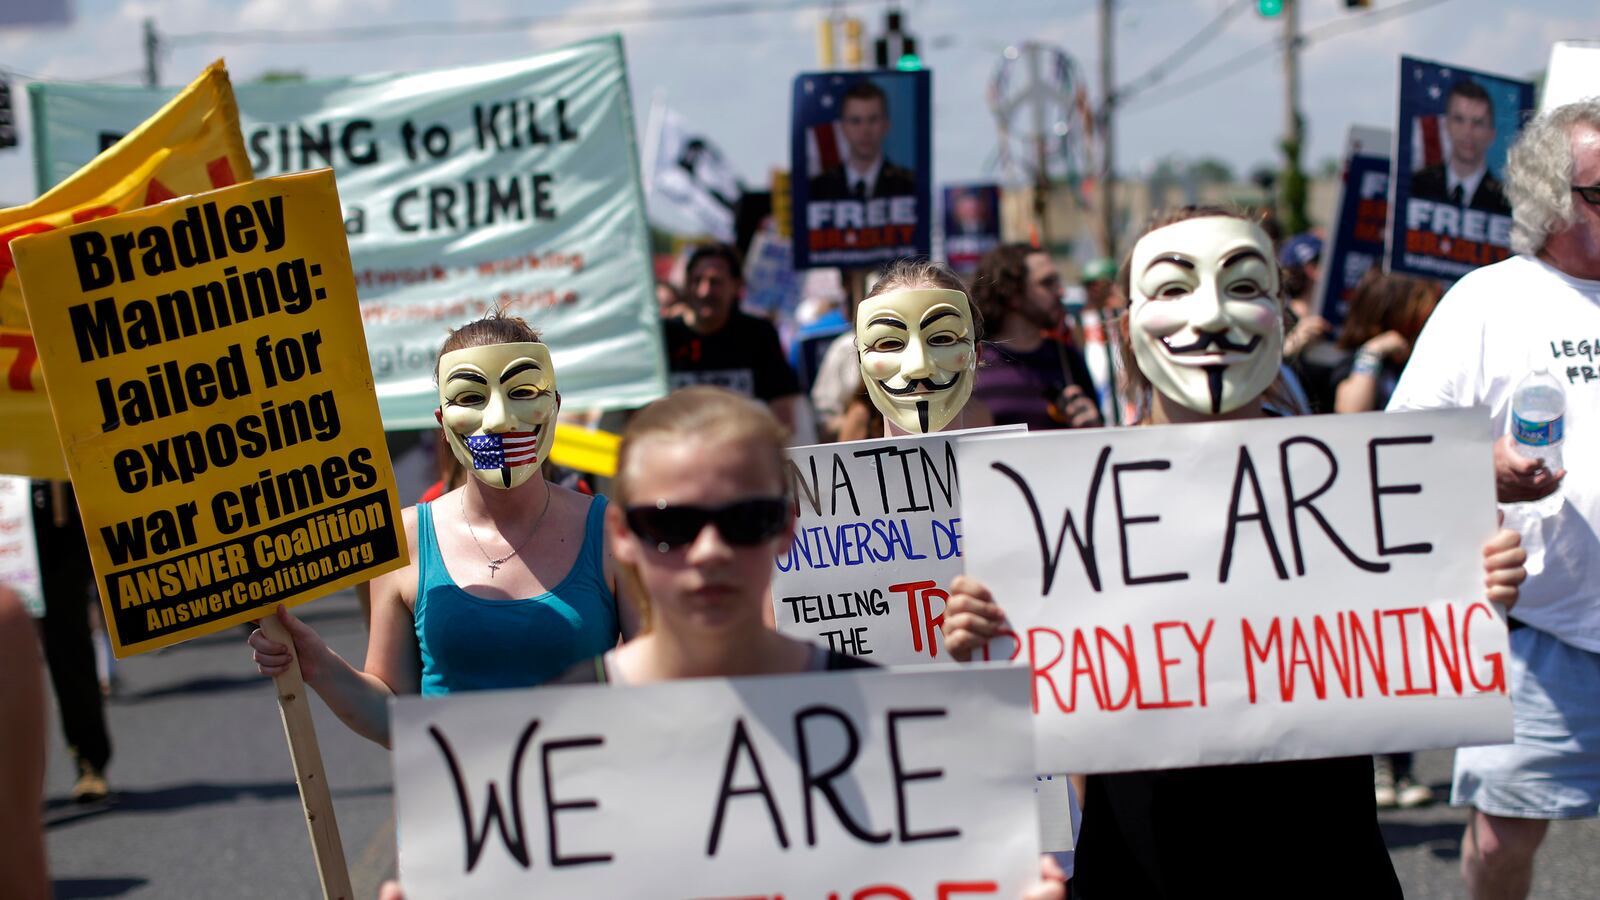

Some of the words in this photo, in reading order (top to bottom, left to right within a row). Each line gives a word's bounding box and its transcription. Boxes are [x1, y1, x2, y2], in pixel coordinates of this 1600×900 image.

[400, 119, 450, 161] to
[473, 97, 578, 150] KILL
[70, 196, 286, 293] Bradley
[345, 206, 366, 236] a
[393, 173, 557, 234] CRIME
[807, 196, 917, 229] FREE
[1407, 198, 1513, 247] FREE
[69, 257, 327, 363] Manning:
[96, 344, 251, 433] Jailed
[255, 329, 322, 389] for
[113, 389, 341, 494] exposing
[100, 500, 199, 566] war
[211, 447, 377, 535] crimes
[775, 518, 927, 572] UNIVERSAL
[990, 446, 1189, 596] WE
[1219, 435, 1435, 583] ARE
[117, 539, 249, 610] ANSWER
[253, 501, 385, 568] Coalition
[147, 540, 375, 633] AnswerCoalition.org
[782, 588, 889, 624] TELLING
[819, 627, 874, 655] THE
[1241, 602, 1506, 704] MANNING
[428, 718, 613, 873] WE
[707, 705, 962, 857] ARE
